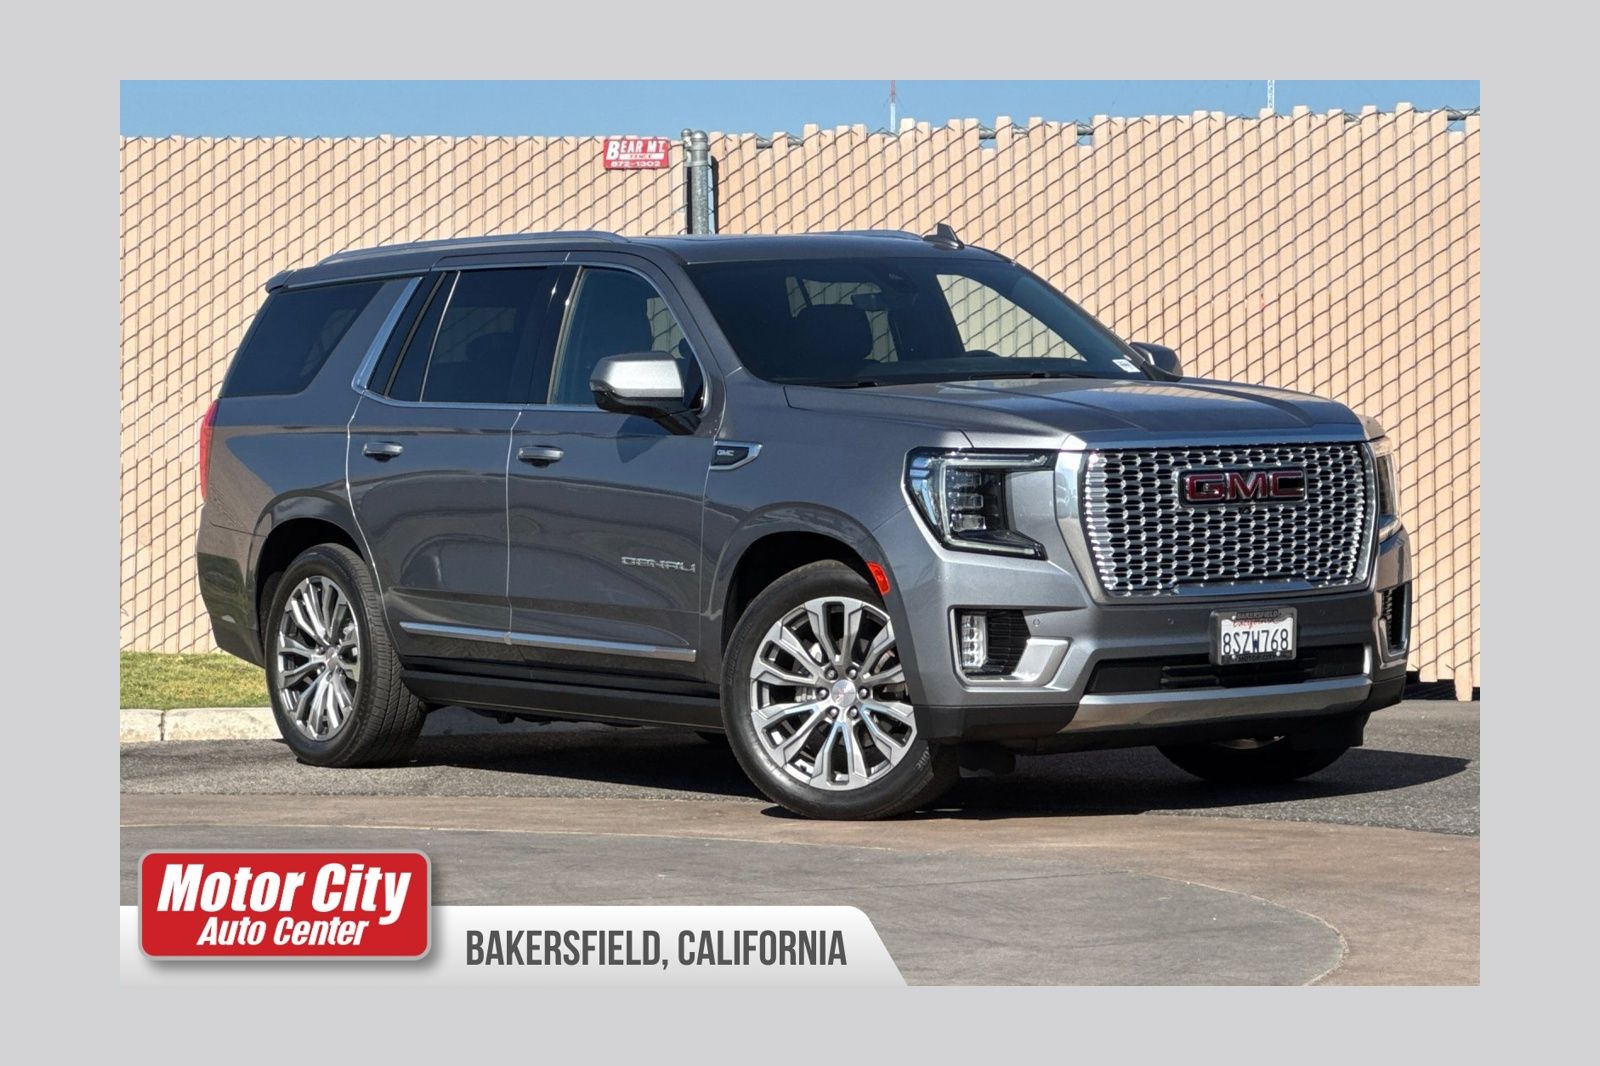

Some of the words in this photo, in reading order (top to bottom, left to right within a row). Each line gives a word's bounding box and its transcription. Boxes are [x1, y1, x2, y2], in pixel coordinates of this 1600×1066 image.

[606, 141, 643, 160] BEAR
[1185, 470, 1305, 501] GMC
[621, 556, 696, 573] DENALI
[1223, 628, 1289, 655] 8SZW768
